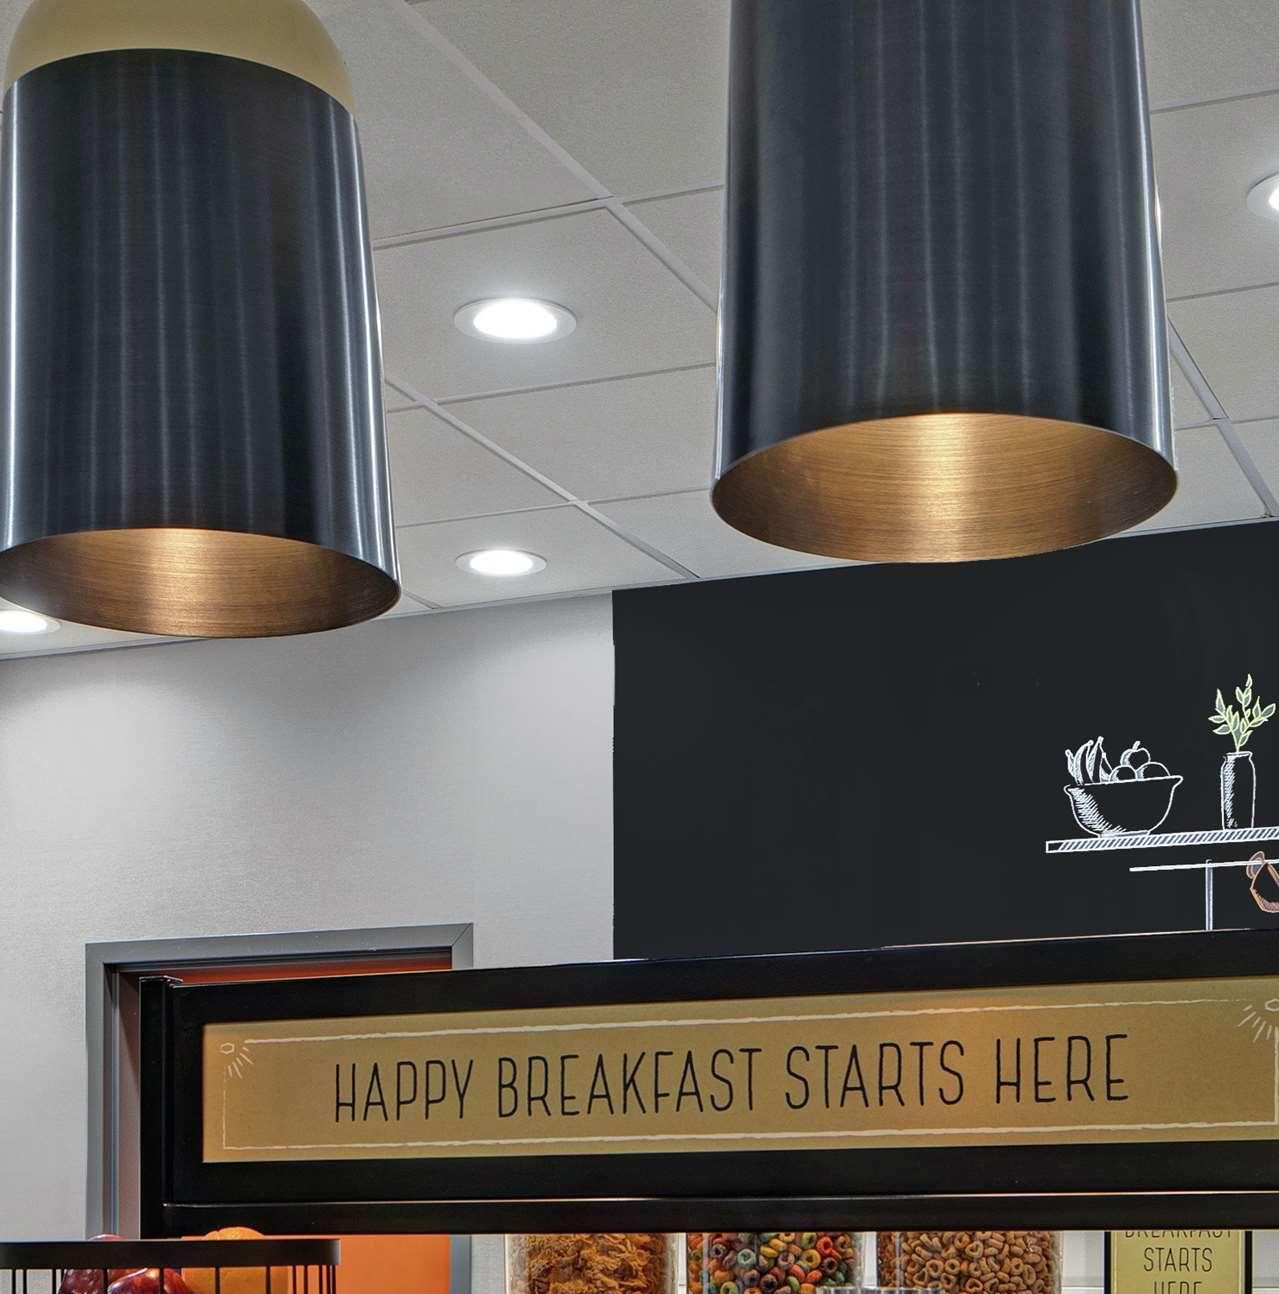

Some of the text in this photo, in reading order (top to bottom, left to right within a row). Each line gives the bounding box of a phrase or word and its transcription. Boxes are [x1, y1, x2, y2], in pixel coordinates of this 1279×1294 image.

[335, 1033, 1130, 1123] HAPPY BREAKFAST STARTS HERE
[1143, 1247, 1213, 1273] STARTS
